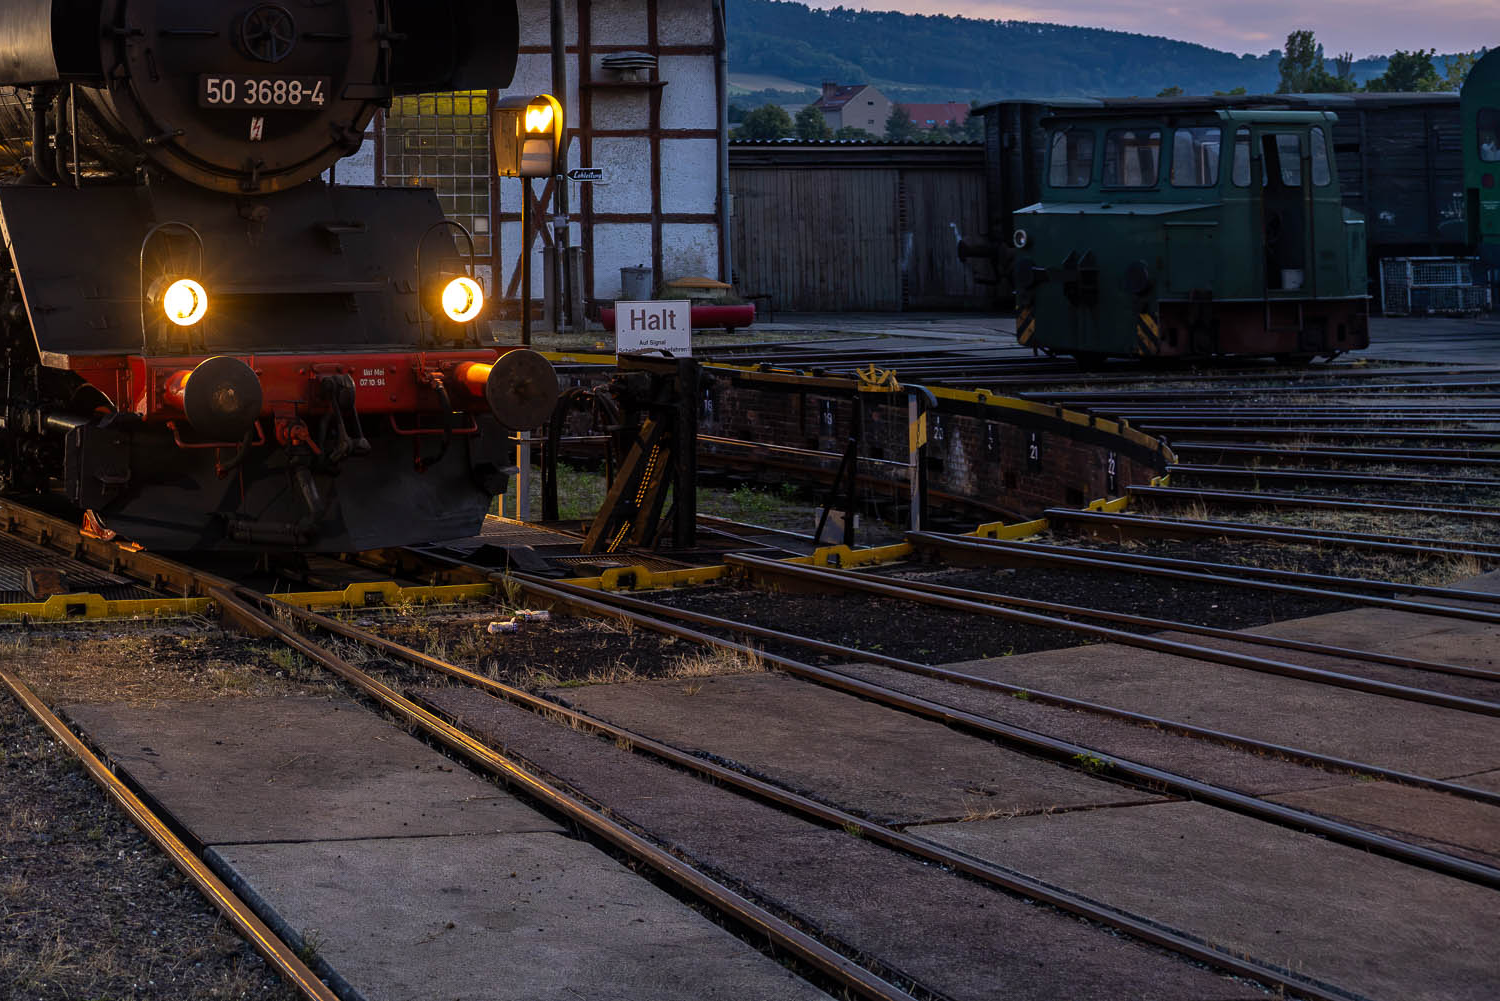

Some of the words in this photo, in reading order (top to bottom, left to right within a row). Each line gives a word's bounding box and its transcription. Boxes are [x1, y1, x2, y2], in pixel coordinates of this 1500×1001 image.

[206, 78, 236, 104] 50
[243, 79, 325, 105] 3688-4
[630, 308, 677, 331] Halt
